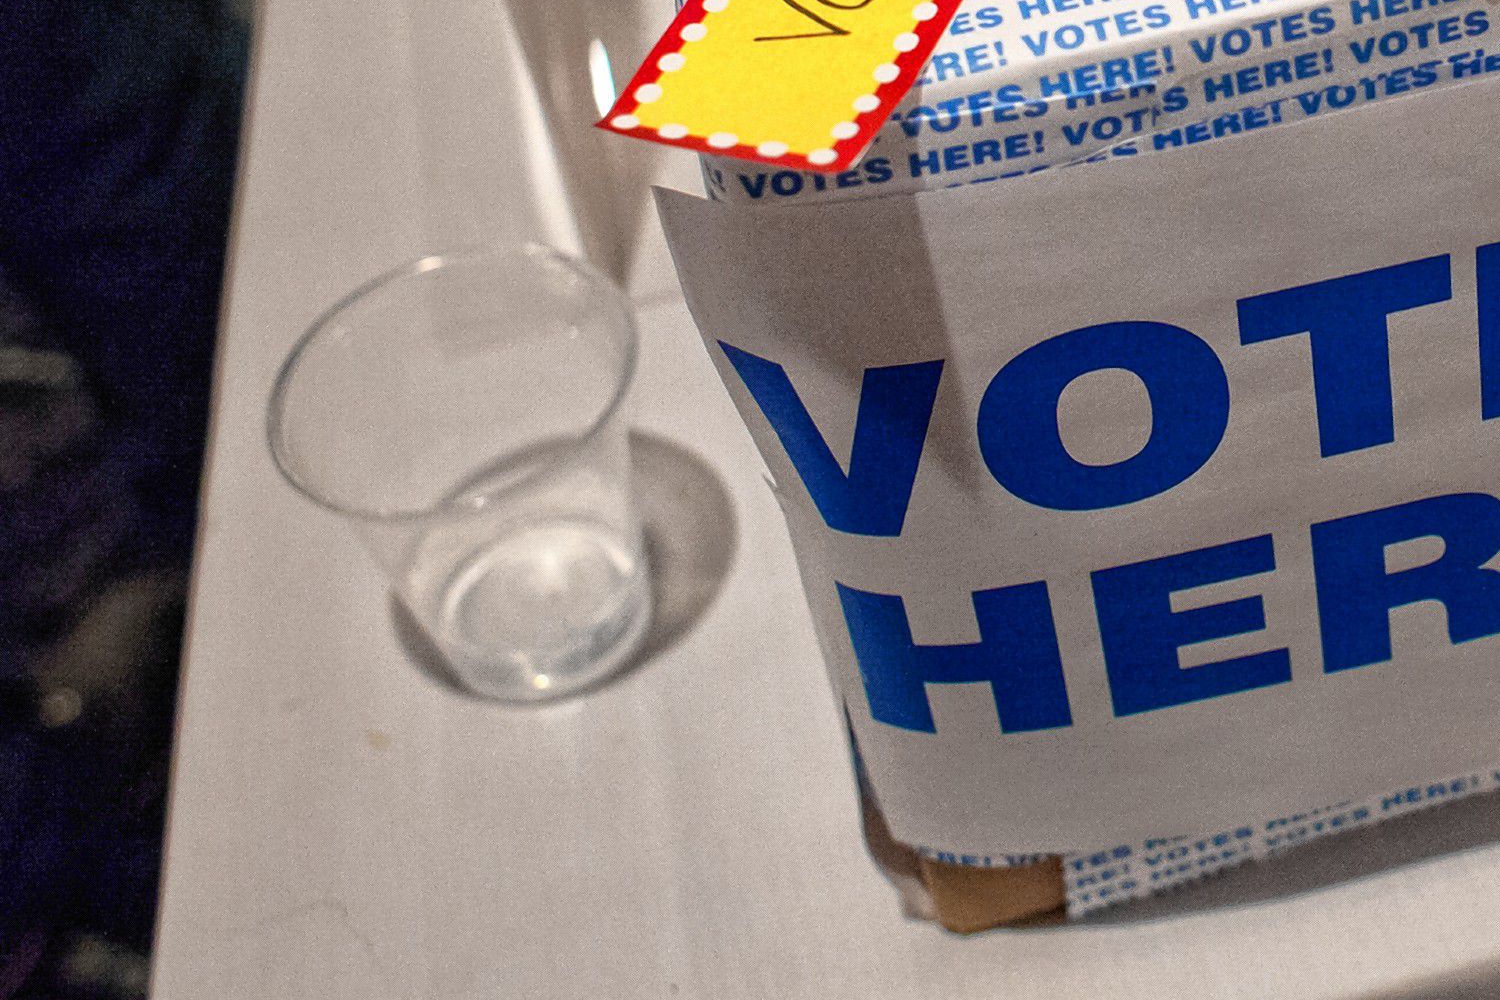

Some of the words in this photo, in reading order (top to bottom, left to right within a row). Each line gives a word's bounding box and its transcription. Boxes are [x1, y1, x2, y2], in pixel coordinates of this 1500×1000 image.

[1022, 3, 1171, 58] VOTES
[1189, 6, 1337, 64] VOTES
[1203, 48, 1334, 103] HERE!
[1349, 8, 1492, 64] VOTES
[908, 130, 1046, 179] HERE!
